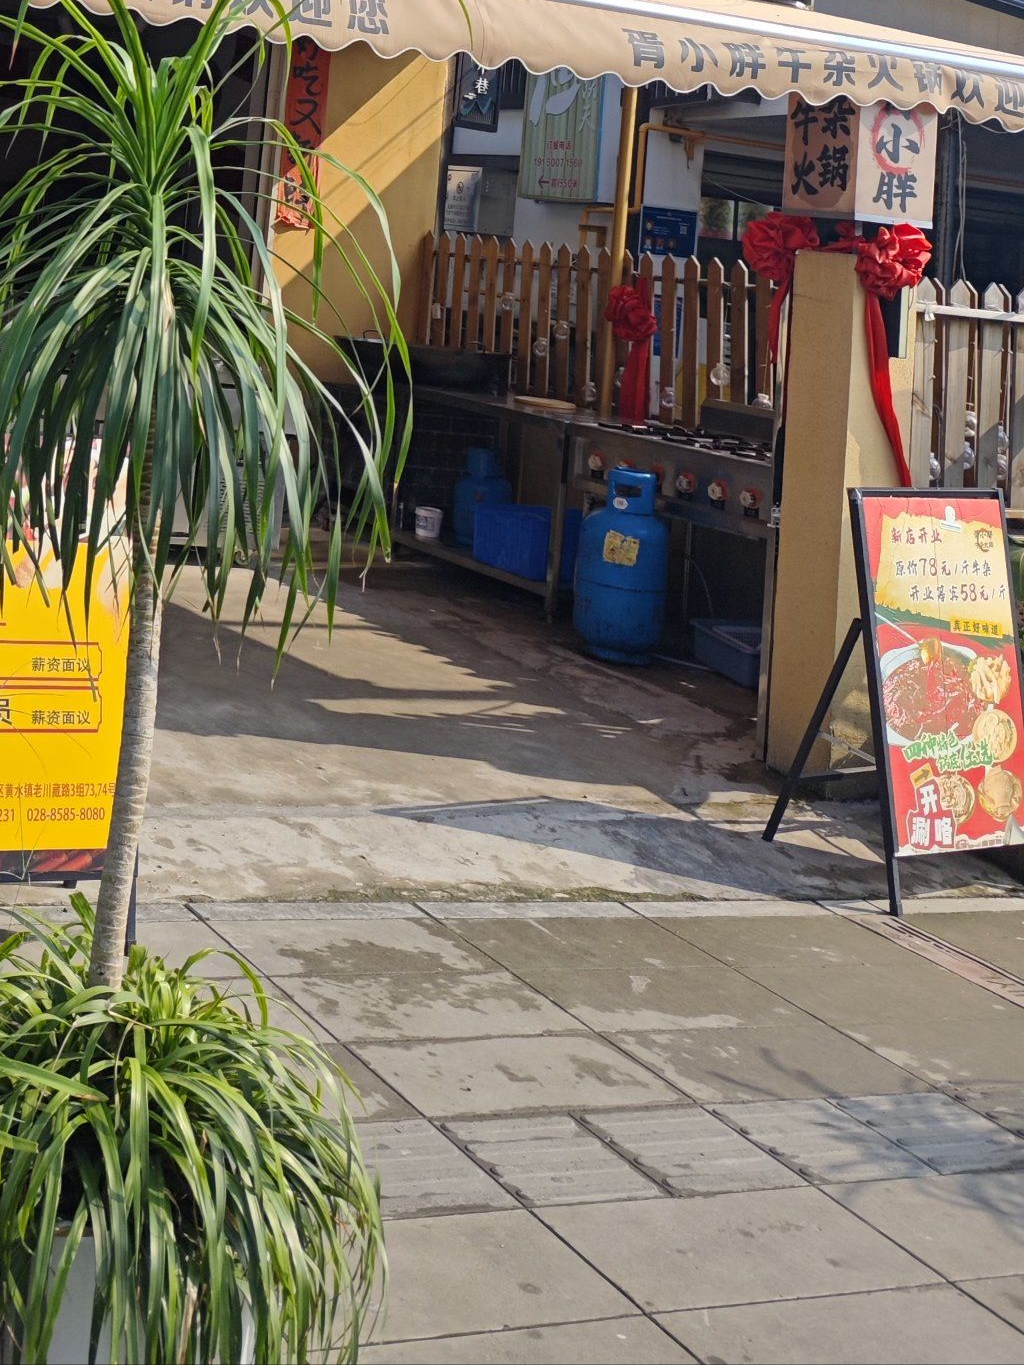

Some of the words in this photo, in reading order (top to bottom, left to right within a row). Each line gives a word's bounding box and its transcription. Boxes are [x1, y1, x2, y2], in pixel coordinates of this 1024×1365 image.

[871, 102, 920, 213] 小胖
[890, 527, 943, 545] 新店开业
[952, 619, 999, 635] 真正好味道
[31, 656, 91, 672] 薪资面议
[31, 709, 91, 725] 薪资面议
[26, 807, 106, 822] 028-8585-8080
